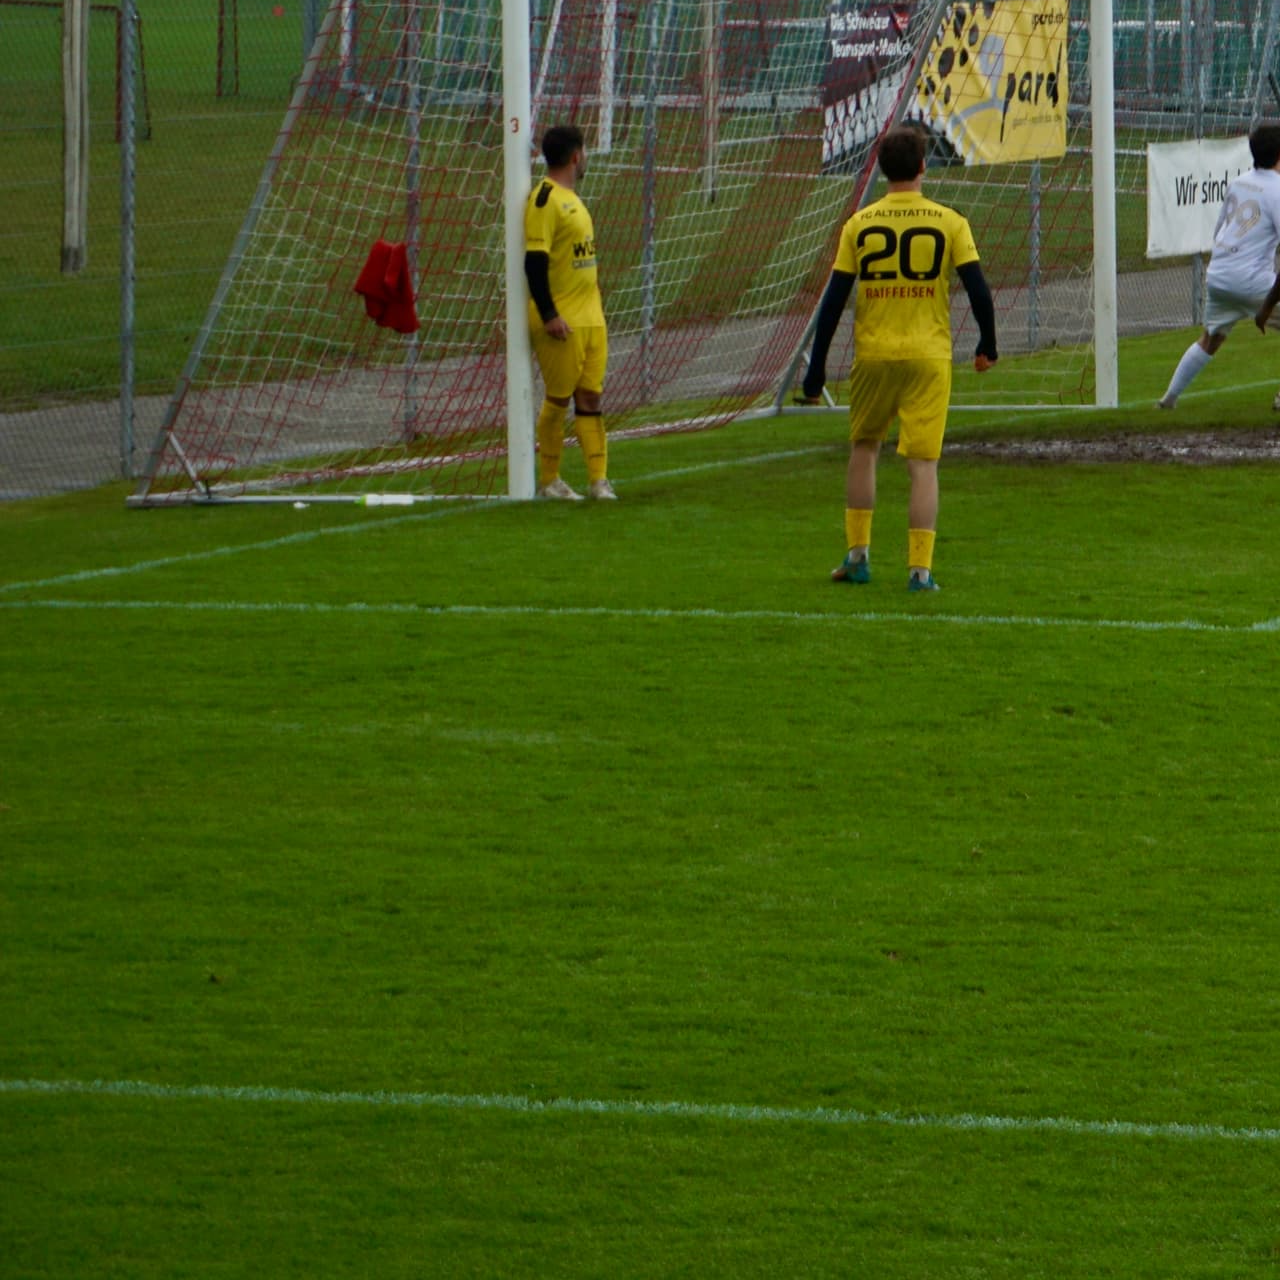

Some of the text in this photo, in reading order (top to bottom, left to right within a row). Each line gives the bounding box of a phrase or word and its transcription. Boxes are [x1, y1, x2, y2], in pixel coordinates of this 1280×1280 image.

[1175, 169, 1228, 207] Wir sind
[857, 225, 946, 281] 20
[865, 286, 935, 299] RAIFFEISEN
